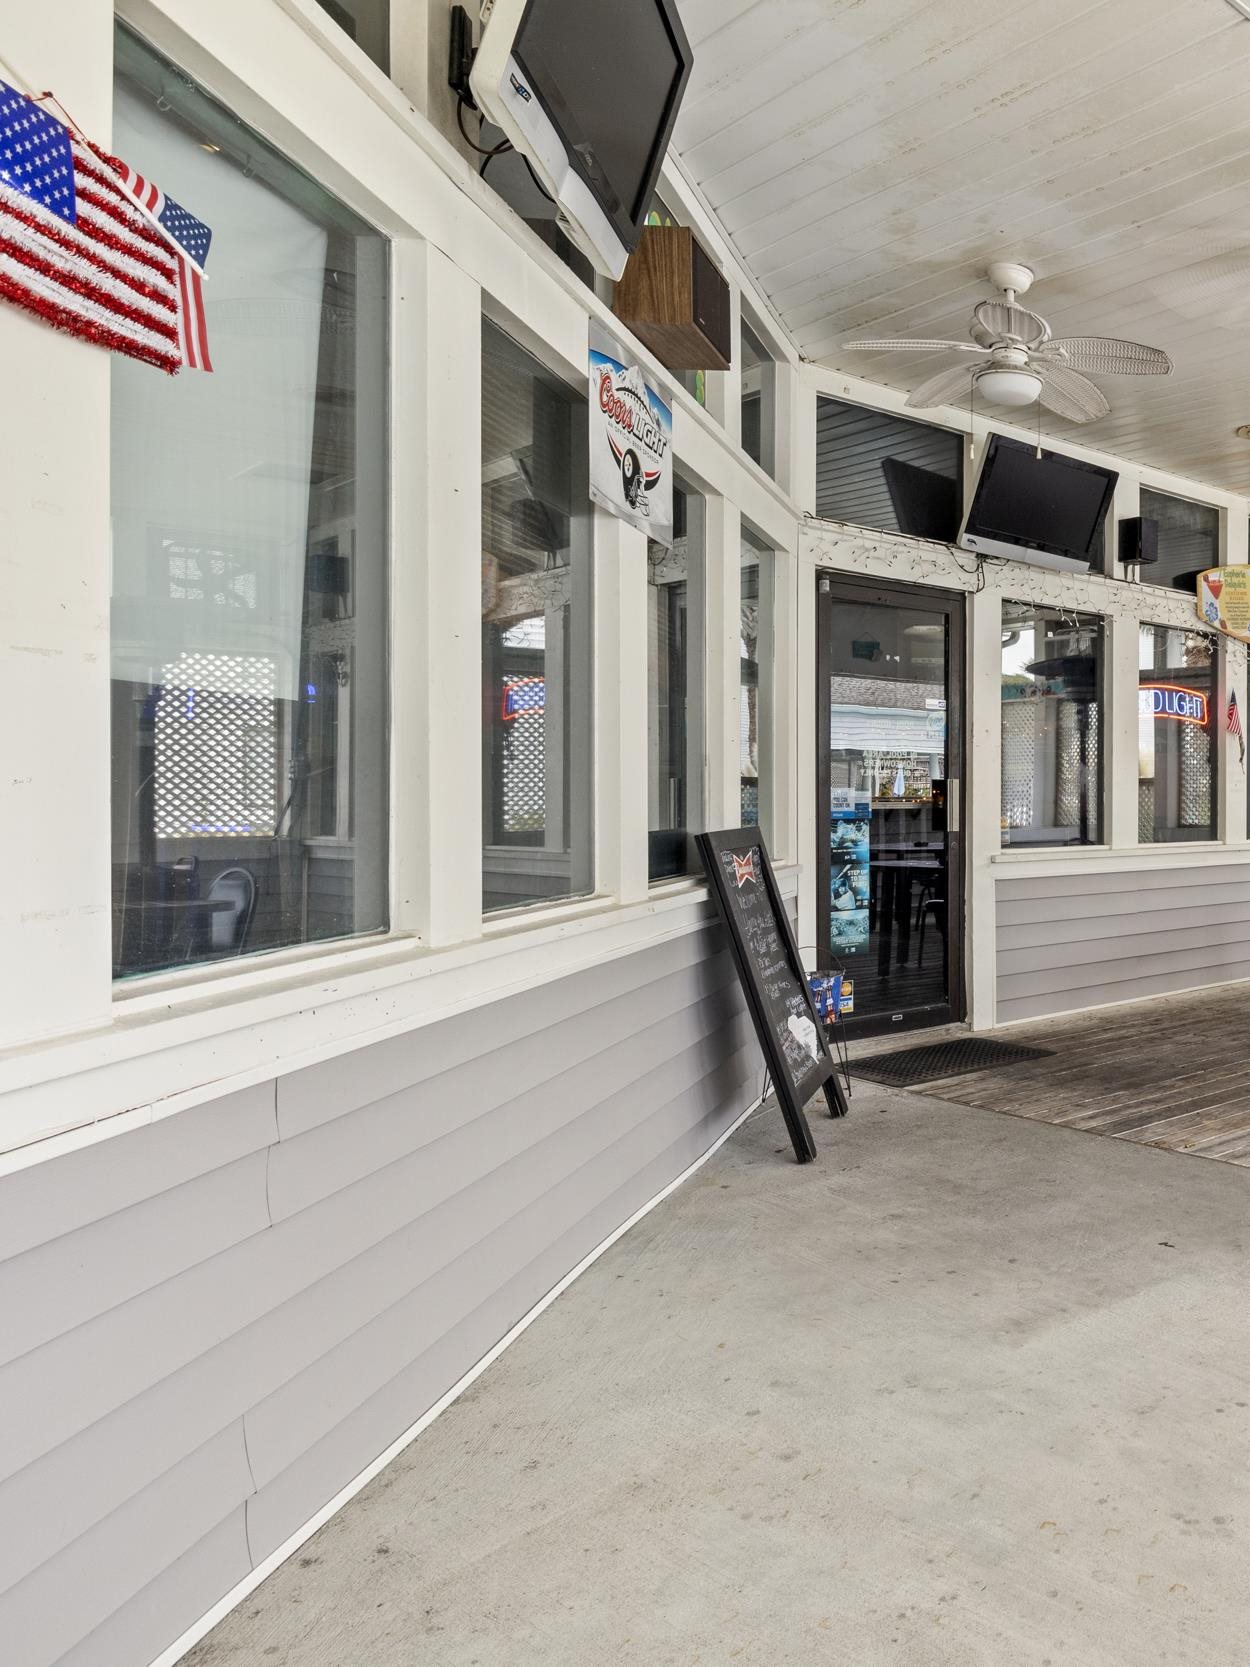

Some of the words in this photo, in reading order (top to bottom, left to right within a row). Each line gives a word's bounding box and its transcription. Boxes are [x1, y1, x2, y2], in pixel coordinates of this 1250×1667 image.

[600, 373, 633, 434] Coors
[632, 412, 668, 458] LIGHT
[1165, 691, 1202, 718] LIGHT
